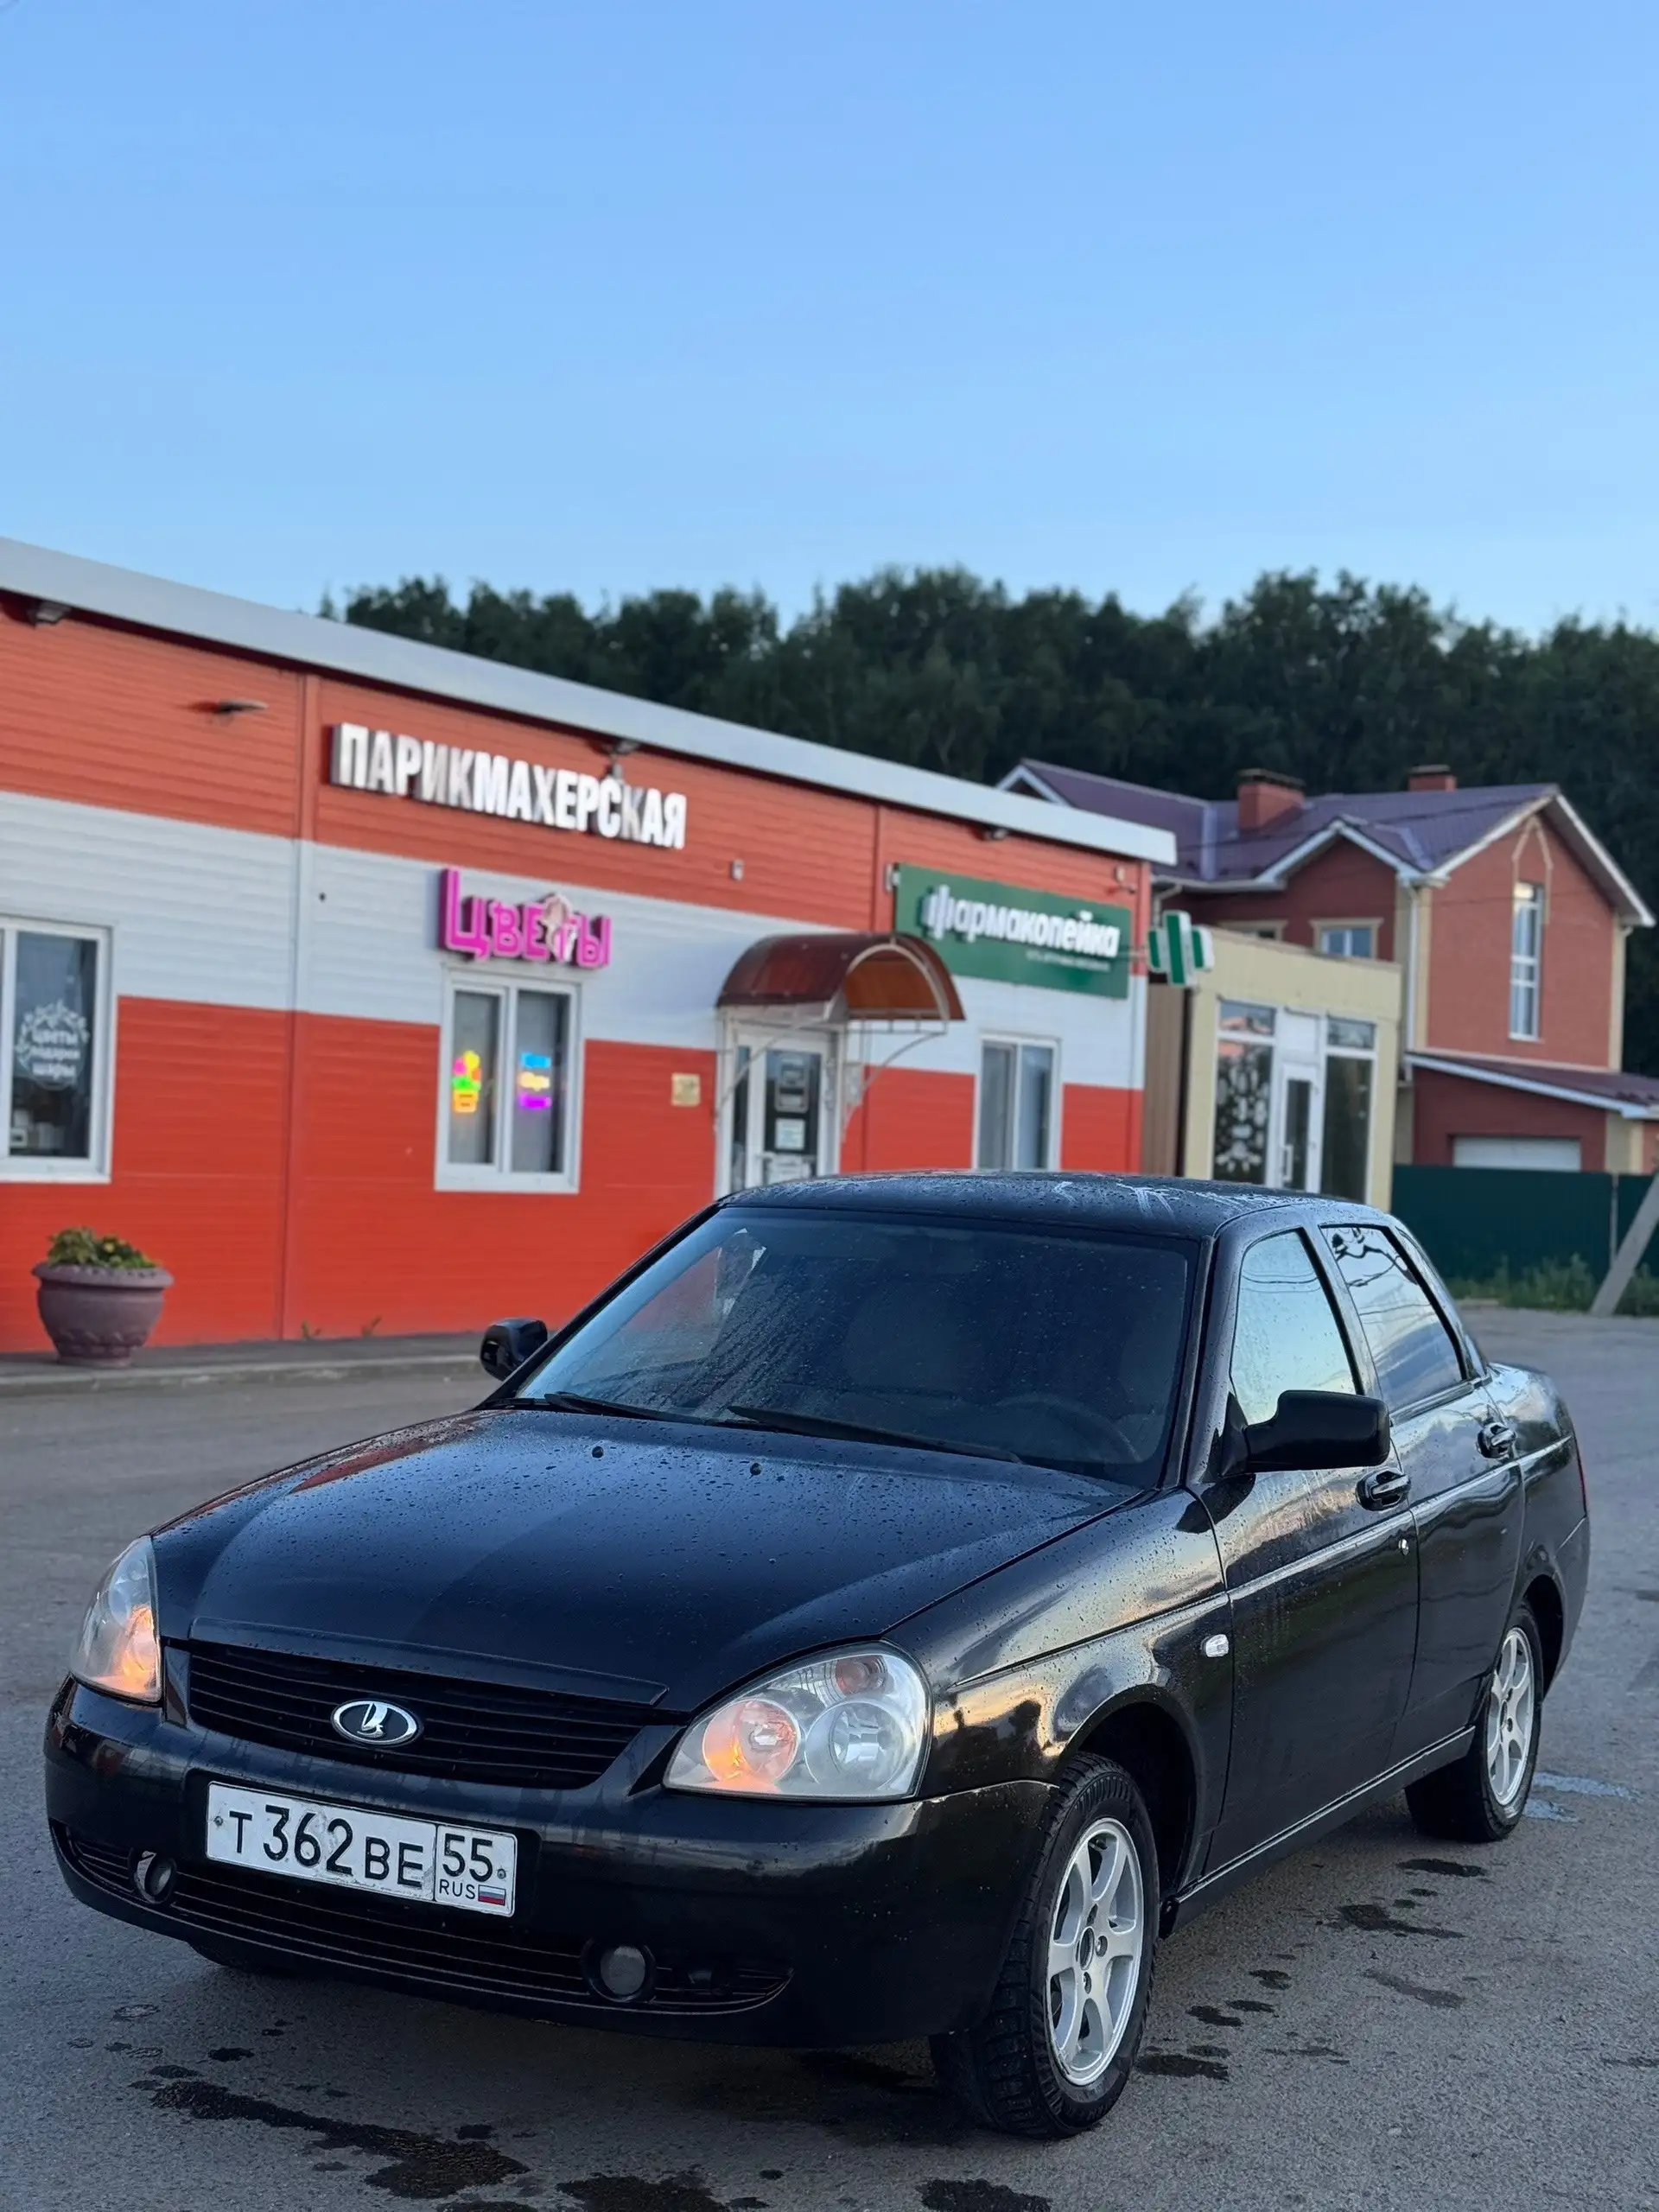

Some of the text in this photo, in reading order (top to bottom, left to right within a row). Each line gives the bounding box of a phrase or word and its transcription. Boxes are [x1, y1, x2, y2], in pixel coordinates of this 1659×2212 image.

[334, 721, 688, 850] ПАРИКМАХЕРСКАЯ
[923, 884, 1121, 957] фармакопейка
[442, 1833, 493, 1883] 55
[438, 1878, 476, 1900] RUS
